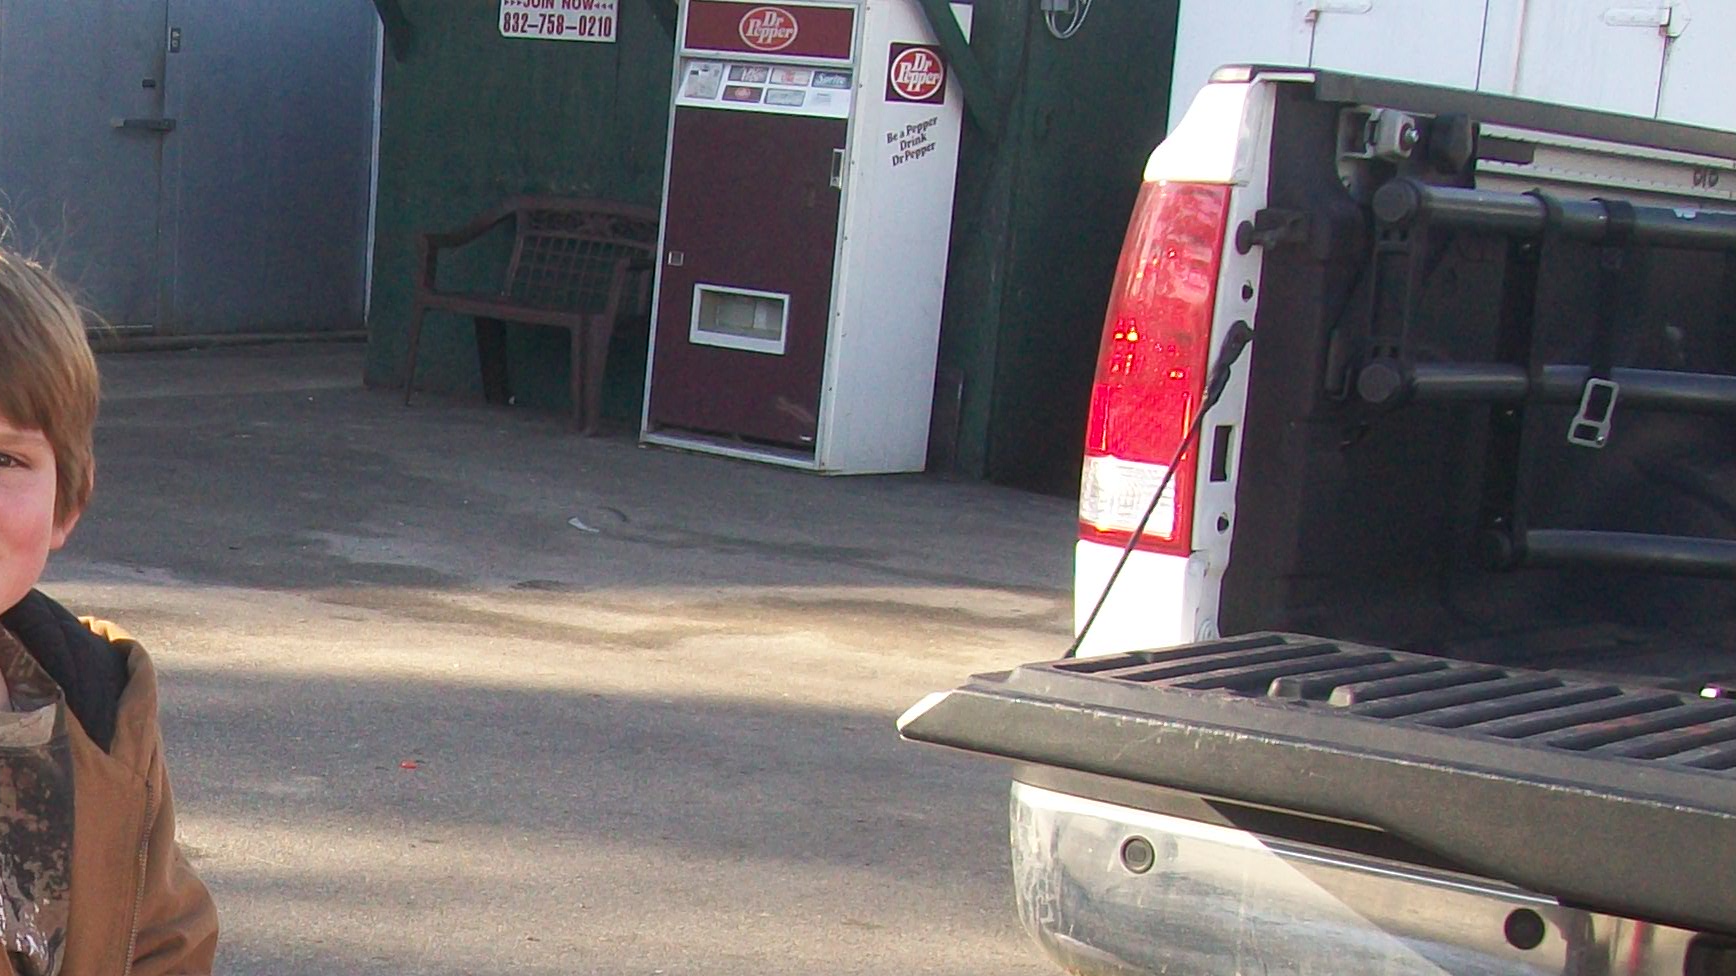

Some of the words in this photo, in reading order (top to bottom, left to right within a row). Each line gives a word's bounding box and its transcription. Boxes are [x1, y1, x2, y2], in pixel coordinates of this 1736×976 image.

[503, 11, 612, 37] 832-758-0210
[745, 18, 794, 44] Pepper
[761, 11, 784, 27] Dr
[911, 52, 933, 71] Dr
[896, 61, 941, 92] Pepper
[886, 132, 898, 144] Be
[906, 116, 938, 136] Pepper
[900, 133, 927, 151] Drink
[892, 154, 904, 166] Dr
[904, 142, 936, 161] Pepper
